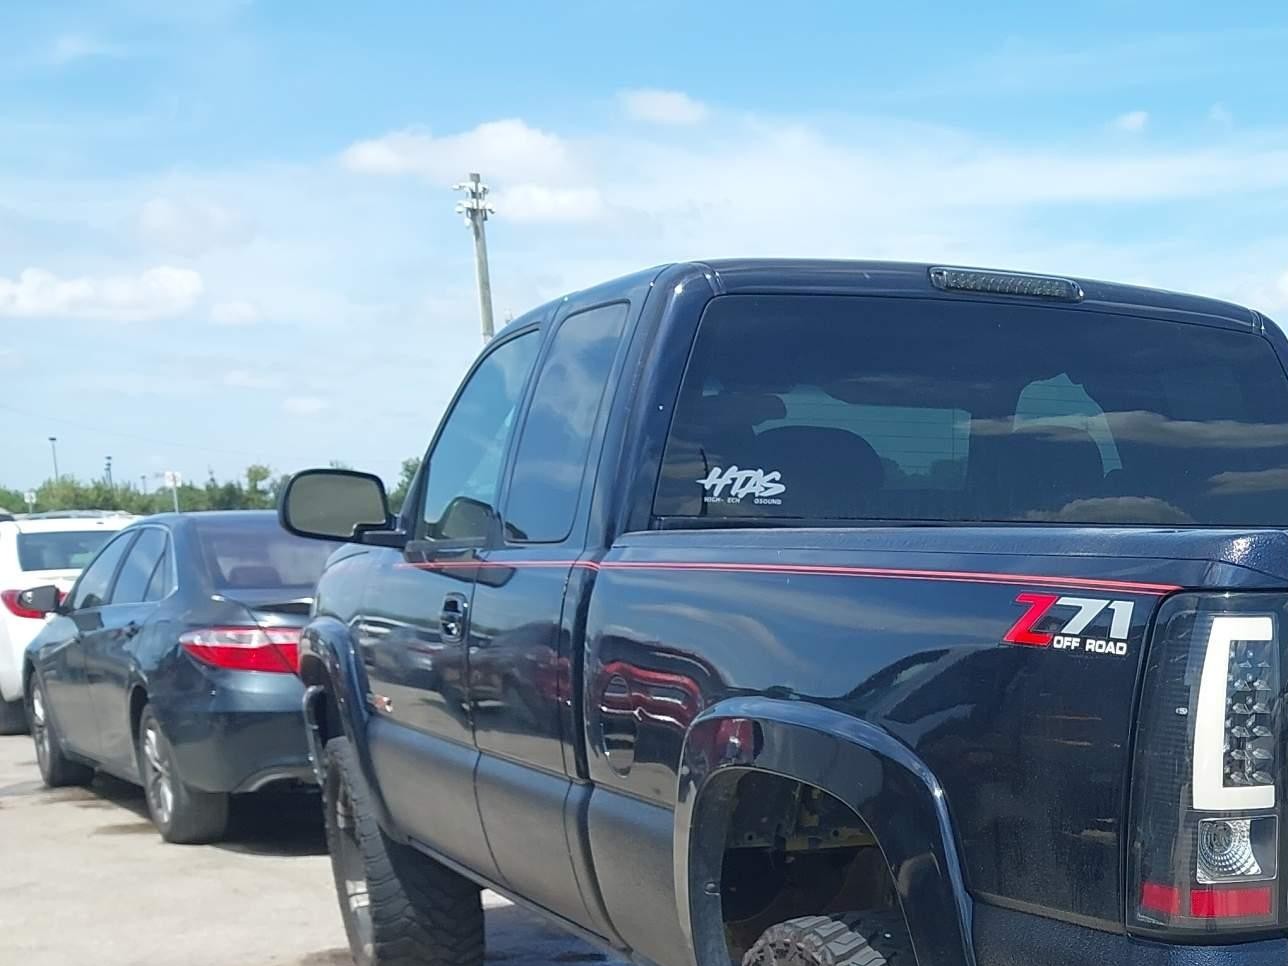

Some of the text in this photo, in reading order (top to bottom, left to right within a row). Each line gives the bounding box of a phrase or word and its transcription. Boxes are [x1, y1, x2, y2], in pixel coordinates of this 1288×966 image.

[696, 465, 786, 498] HTAS
[1003, 593, 1135, 647] Z71
[1053, 636, 1128, 655] OFF ROAD
